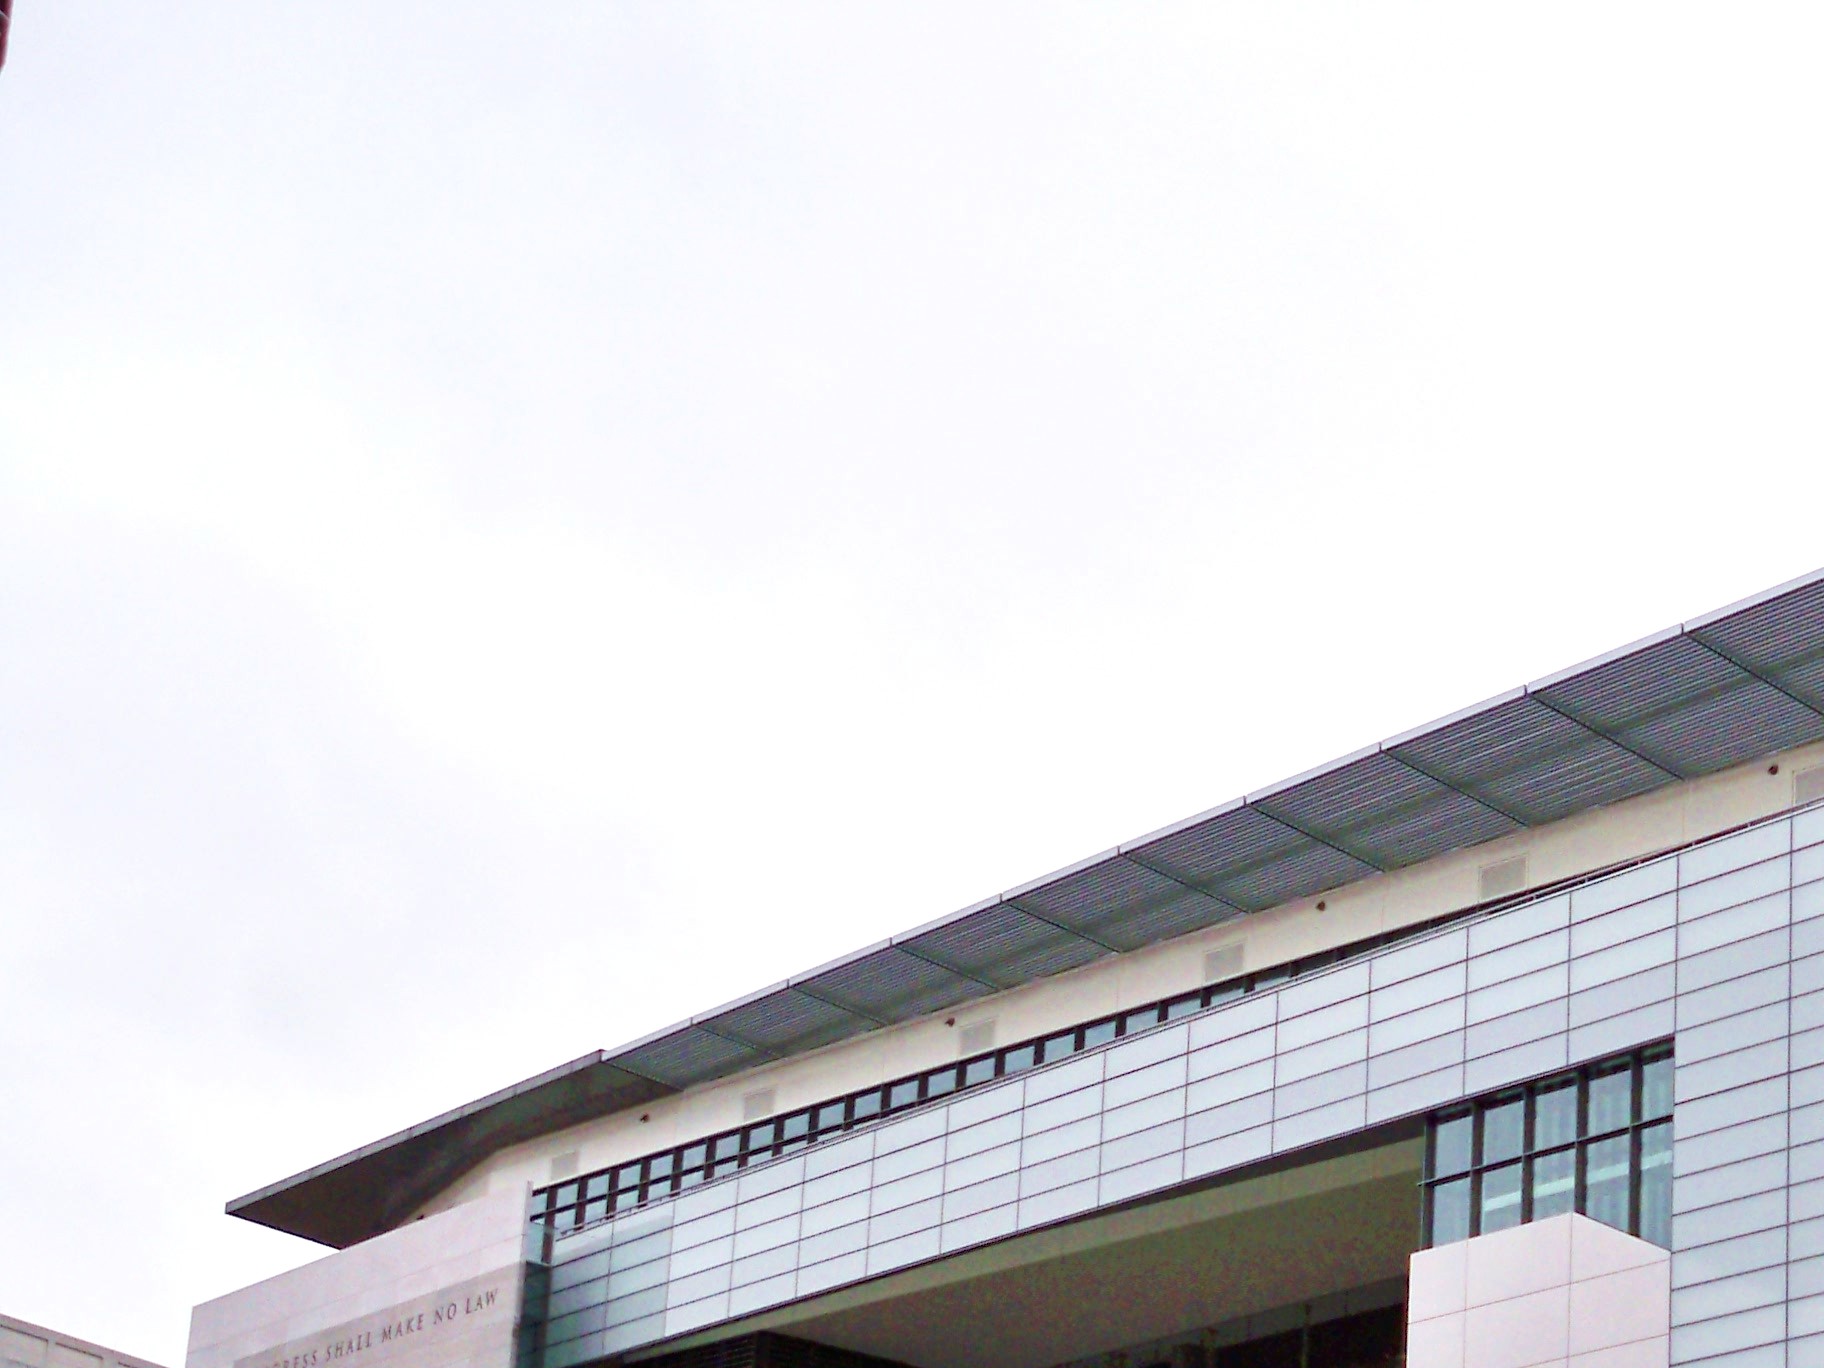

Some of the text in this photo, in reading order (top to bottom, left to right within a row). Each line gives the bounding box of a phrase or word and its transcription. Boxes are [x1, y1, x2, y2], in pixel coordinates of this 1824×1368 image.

[324, 1331, 372, 1362] SHALL
[381, 1312, 424, 1343] MAKE
[433, 1302, 457, 1326] NO
[465, 1288, 498, 1315] LAW
